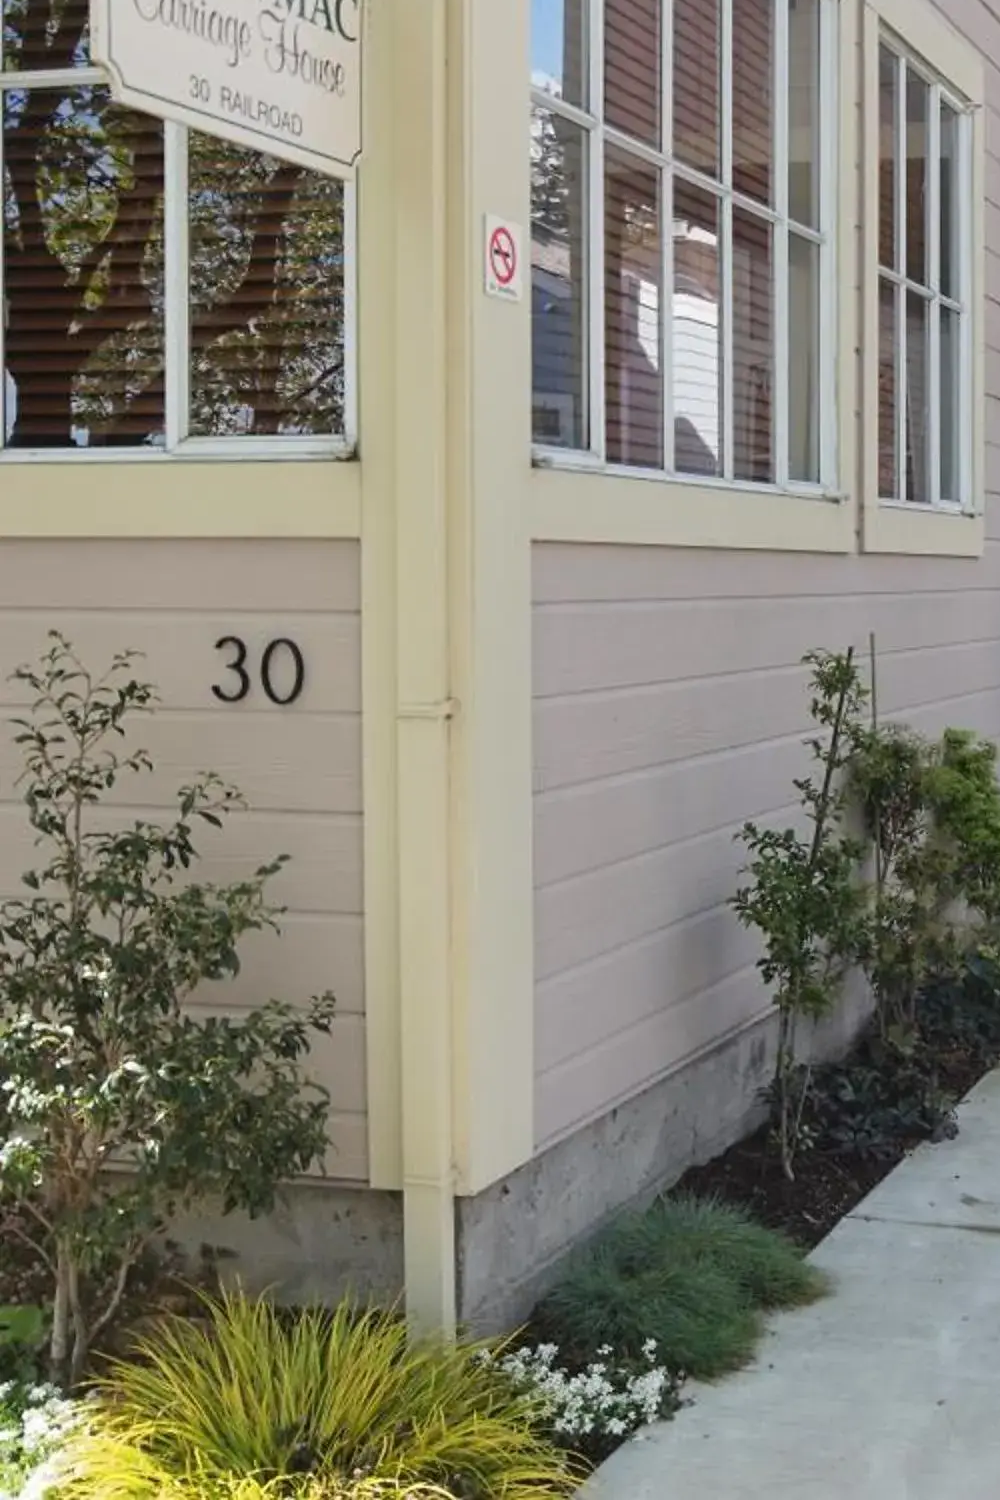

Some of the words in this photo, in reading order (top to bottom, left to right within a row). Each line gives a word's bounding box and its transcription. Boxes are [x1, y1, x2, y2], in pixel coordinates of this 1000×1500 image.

[259, 10, 345, 98] House
[188, 74, 212, 104] 30
[221, 86, 304, 137] RAILROAD
[211, 636, 304, 705] 30
